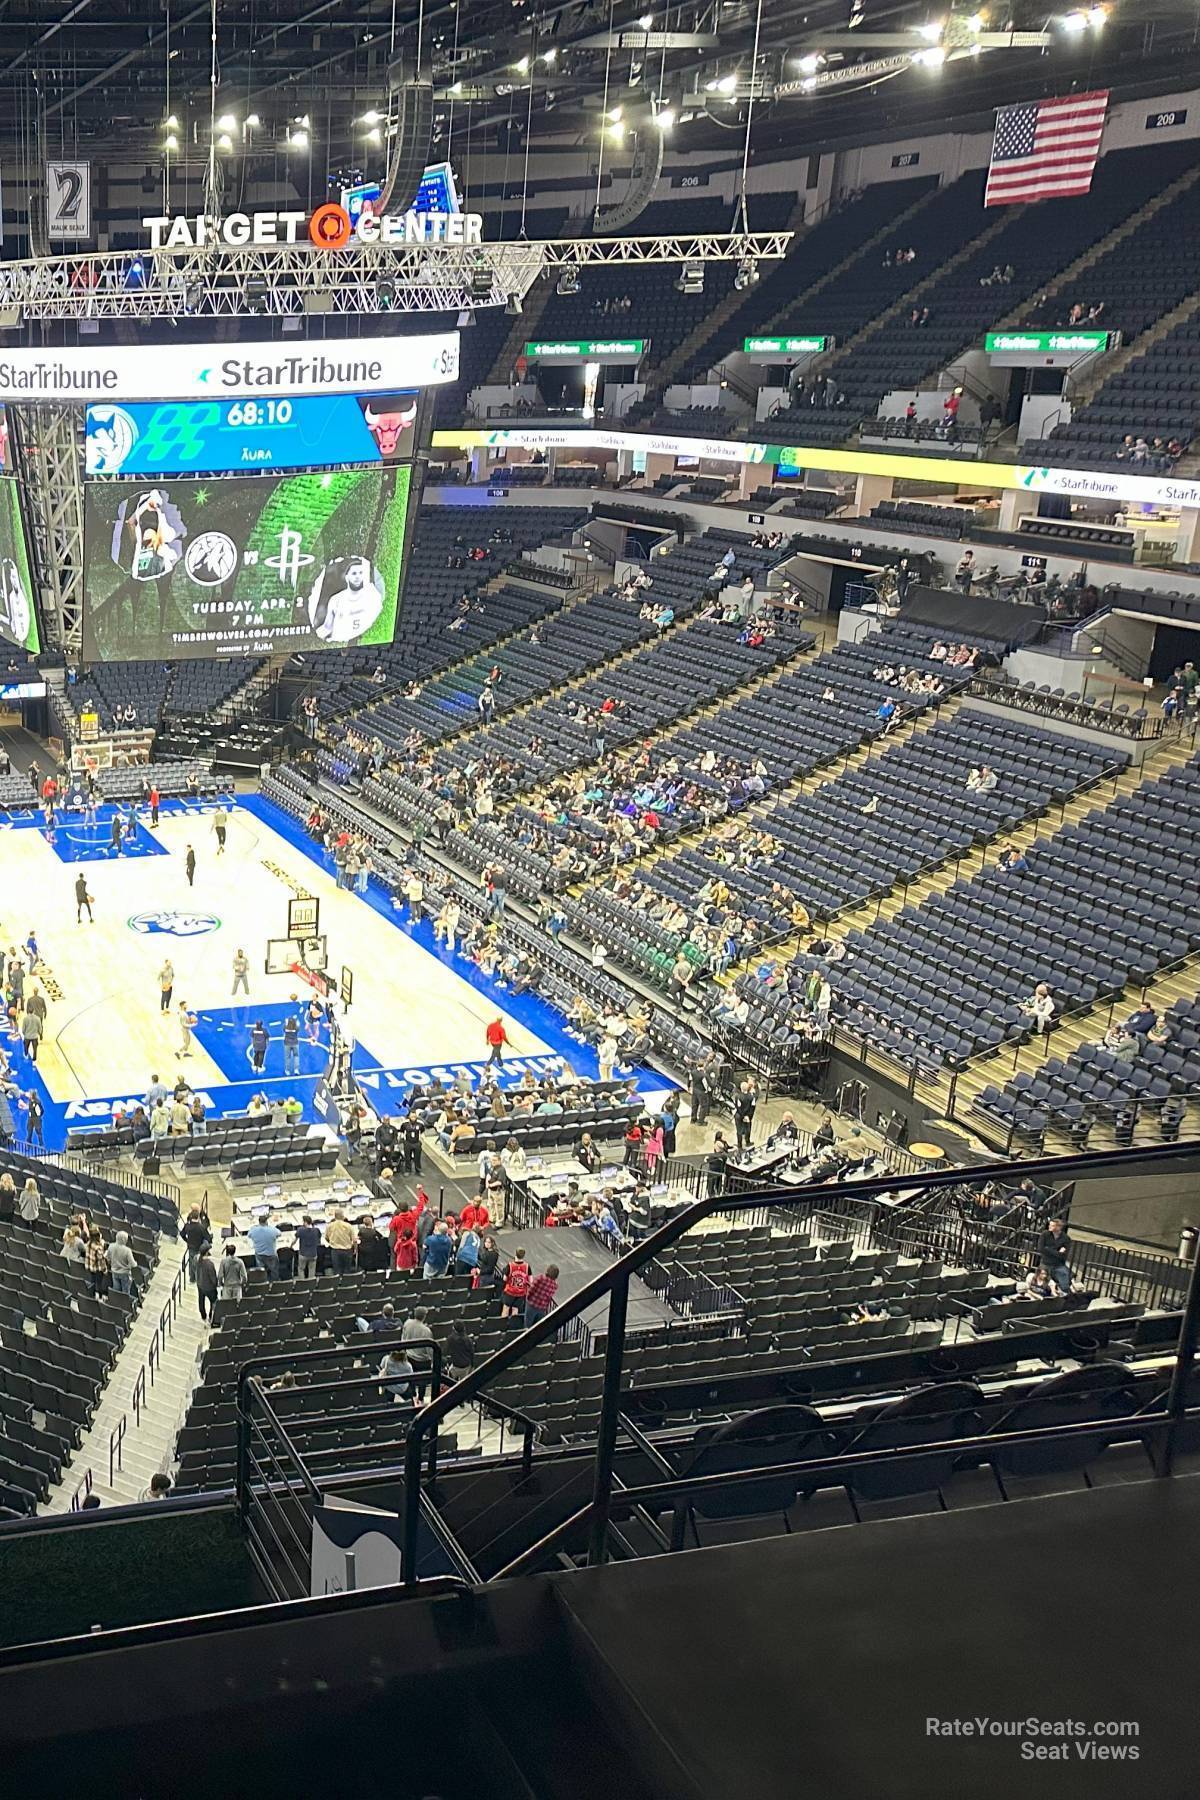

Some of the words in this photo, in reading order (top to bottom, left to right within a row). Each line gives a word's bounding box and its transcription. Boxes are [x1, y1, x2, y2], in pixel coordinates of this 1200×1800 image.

[1156, 112, 1176, 126] 209
[53, 167, 83, 220] 2
[143, 211, 305, 250] TARGET
[357, 213, 483, 244] CENTER
[0, 363, 118, 389] StarTribune
[221, 357, 382, 386] StarTribune
[227, 401, 293, 426] 68:10
[192, 600, 255, 614] TUESDAY,
[260, 598, 291, 610] APR.
[295, 596, 304, 608] 2
[232, 615, 240, 626] 7
[245, 613, 264, 625] PM
[353, 619, 360, 630] 5
[172, 625, 311, 643] TIMBERWOLVES.COM/TICKETS
